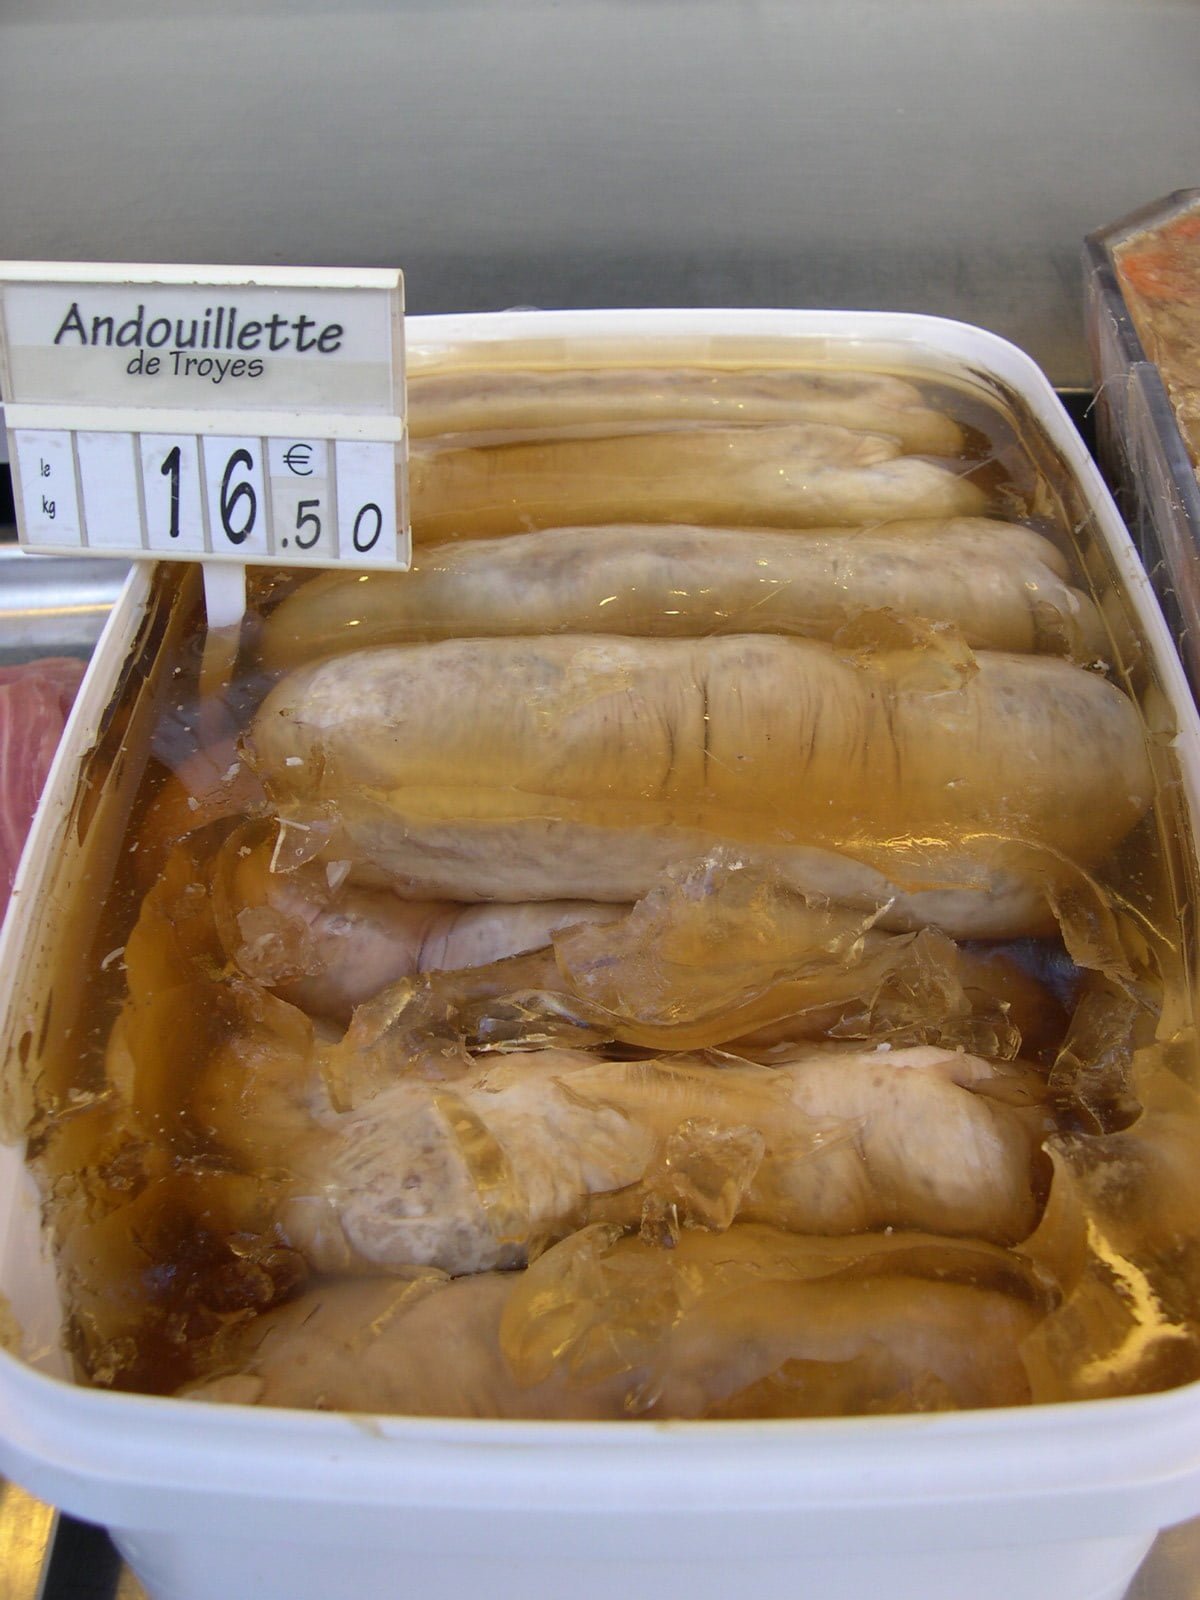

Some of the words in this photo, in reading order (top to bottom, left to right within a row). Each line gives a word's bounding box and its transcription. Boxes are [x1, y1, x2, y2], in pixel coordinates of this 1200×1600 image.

[54, 303, 343, 353] Andouillette
[127, 350, 160, 375] de
[169, 351, 264, 384] Troyes
[42, 494, 56, 519] kg
